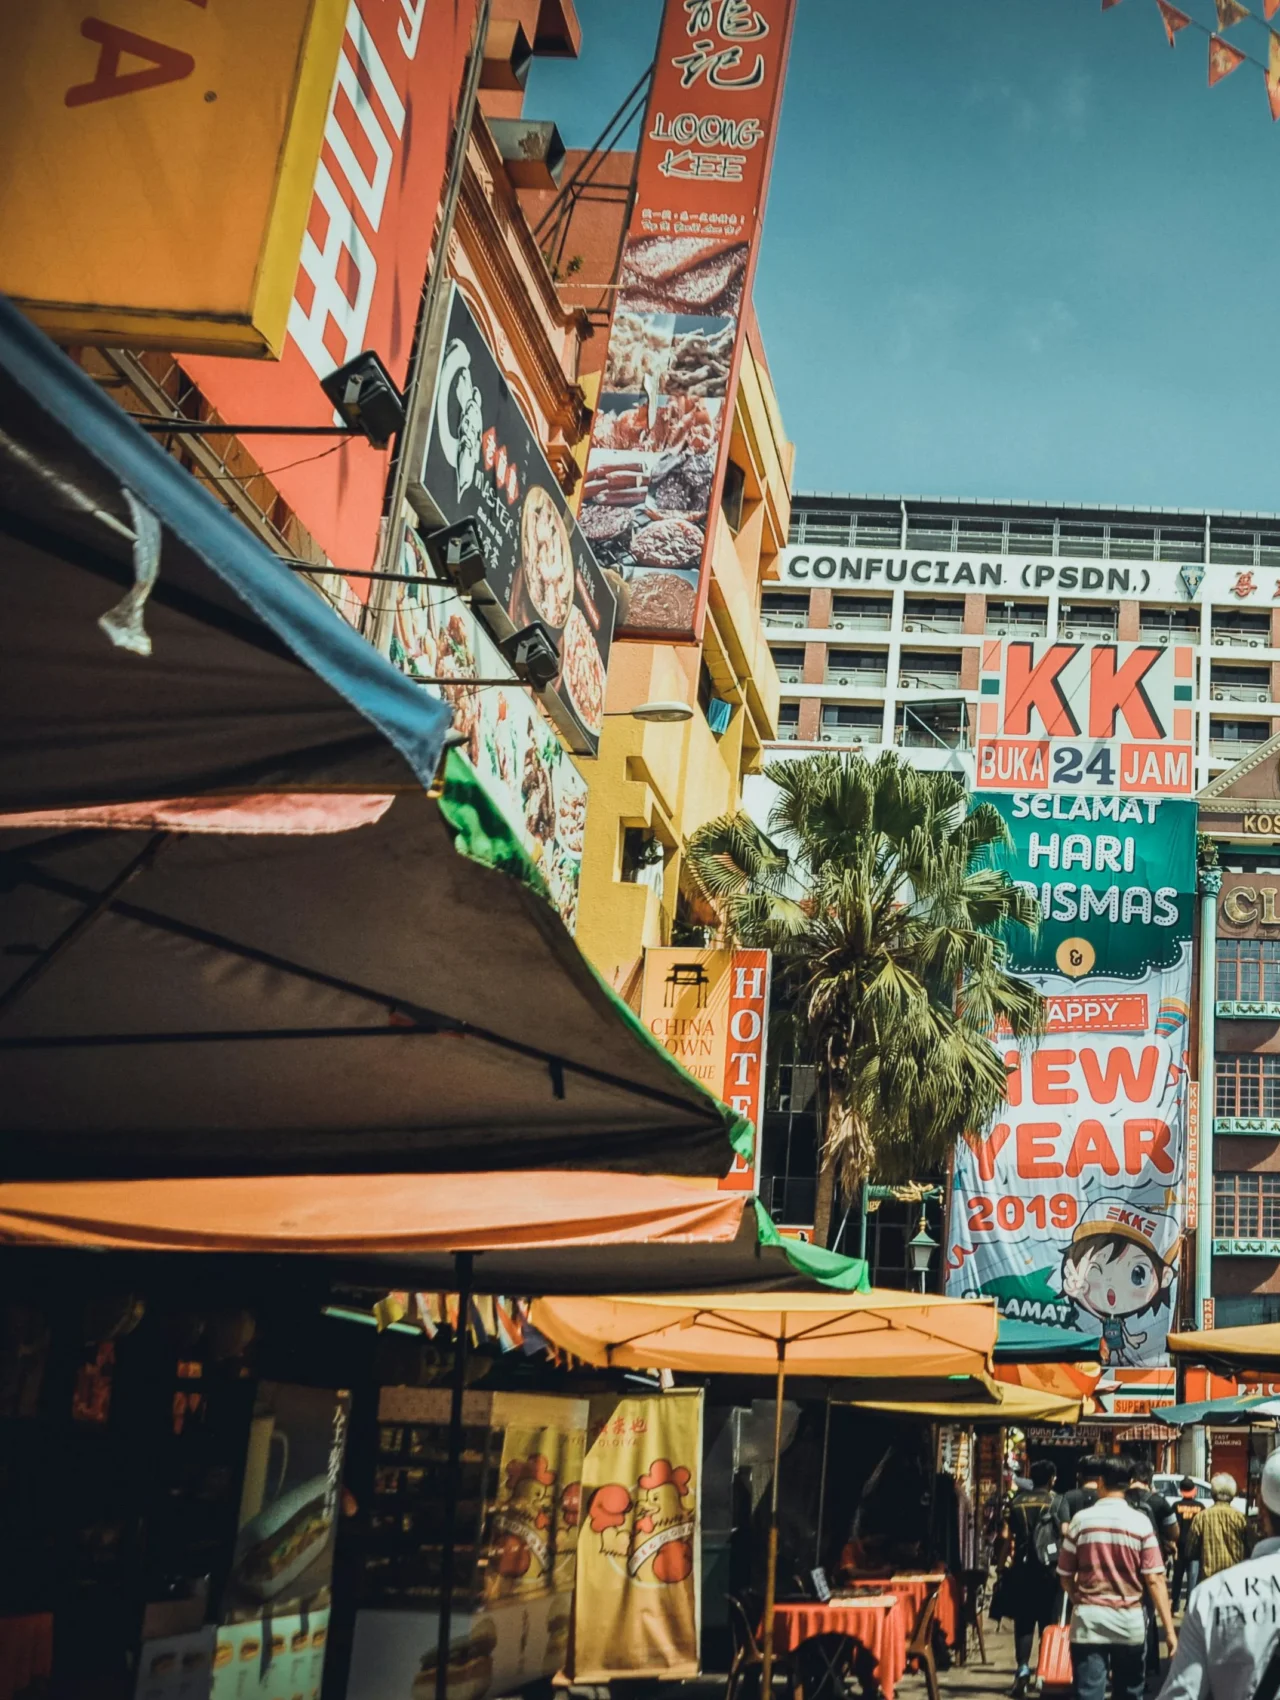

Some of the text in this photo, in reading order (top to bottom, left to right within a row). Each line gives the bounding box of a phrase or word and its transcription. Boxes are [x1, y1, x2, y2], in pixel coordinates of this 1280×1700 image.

[65, 0, 208, 108] A
[650, 112, 765, 150] LOONG
[658, 149, 746, 182] KEE
[475, 469, 514, 539] MASTER
[788, 554, 1002, 586] CONFUCIAN
[1004, 641, 1168, 740] KK
[980, 744, 1188, 786] BUKA 24 JAM
[1012, 793, 1162, 824] SELAMAT
[1028, 832, 1135, 873] HARI
[1012, 881, 1179, 927] ISMAS
[1069, 949, 1083, 967] &
[651, 1018, 715, 1036] CHINA
[1047, 1002, 1120, 1023] APPY
[962, 1118, 1175, 1182] YEAR
[967, 1193, 1078, 1231] 2019
[1117, 1209, 1146, 1234] KK
[1115, 1400, 1144, 1414] SUPER
